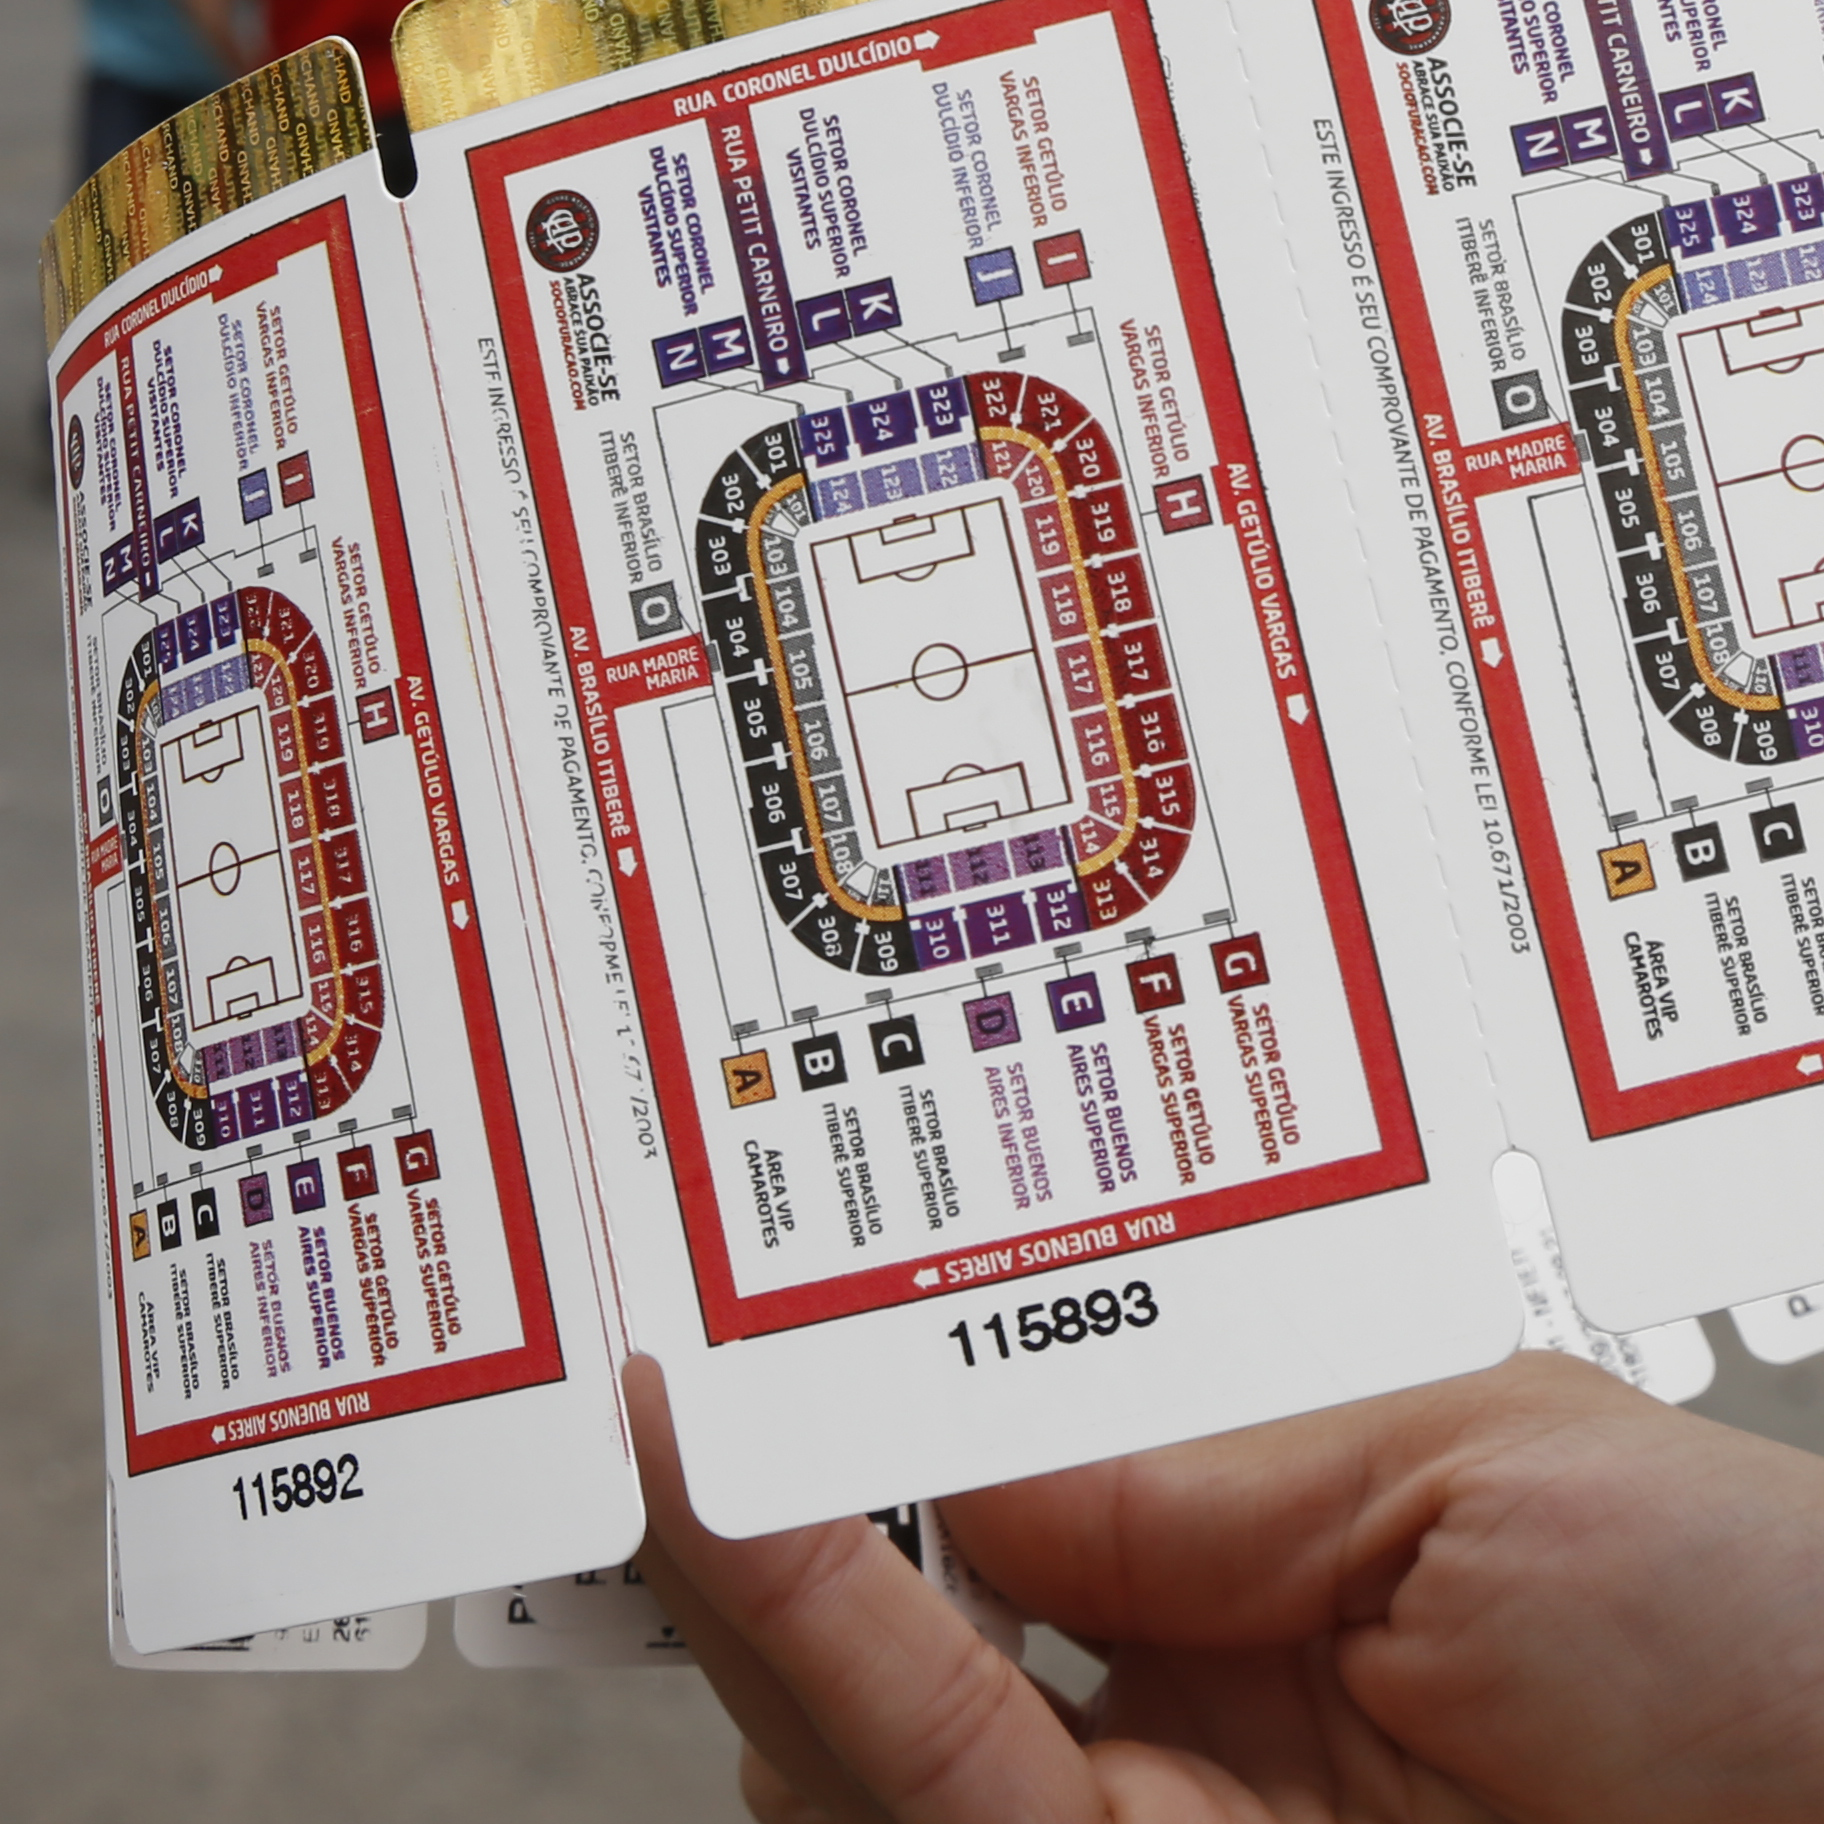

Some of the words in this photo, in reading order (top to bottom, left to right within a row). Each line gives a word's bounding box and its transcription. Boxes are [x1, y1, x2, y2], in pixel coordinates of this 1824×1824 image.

[1521, 14, 1559, 105] SUPERIOR
[1541, 0, 1575, 83] CORONEL
[672, 88, 717, 117] RUA
[721, 61, 816, 104] CORONEL
[816, 30, 913, 77] DULCÍDIO
[1604, 31, 1652, 145] CARNEIRO
[1425, 54, 1477, 190] ASSOCIE-SE
[1672, 100, 1704, 124] L
[1719, 86, 1753, 115] K
[719, 123, 749, 175] RUA
[799, 106, 834, 189] DULCÍDIO
[822, 113, 849, 173] SETOR
[1313, 115, 1342, 167] ESTE
[1524, 130, 1559, 159] N
[1571, 117, 1606, 150] M
[730, 174, 763, 240] PETIT
[785, 146, 821, 251] VISITANTES
[835, 173, 868, 257] CORONEL
[1325, 167, 1367, 271] INGRESSO
[816, 189, 850, 278] SUPERIOR
[103, 322, 119, 348] RUA
[120, 296, 160, 336] CORONEL
[159, 265, 208, 311] DULCÍDIO
[562, 274, 584, 327] ABRACE
[744, 240, 789, 354] CARNEIRO
[1350, 271, 1375, 289] É
[575, 270, 620, 404] ASSOCIE-SE
[1354, 290, 1382, 333] SEU
[572, 327, 590, 356] SUA
[121, 354, 133, 402] RUA
[578, 355, 602, 408] PAIXÃO
[1502, 382, 1538, 416] O
[125, 401, 139, 463] PETIT
[1365, 333, 1420, 491] COMPROVANTE
[1422, 410, 1448, 445] AV.
[764, 431, 789, 473] 301
[1225, 459, 1252, 496] AV.
[1463, 449, 1502, 471] RUA
[1505, 433, 1567, 461] MADRE
[1508, 452, 1567, 480] MARIA
[131, 463, 150, 568] CARNEIRO
[721, 472, 745, 514] 302
[1403, 491, 1428, 524] DE
[1430, 446, 1476, 546] BRASÍLIO
[708, 535, 732, 577] 303
[1234, 497, 1279, 591] GETÚLIO
[331, 536, 352, 606] VARGAS
[342, 607, 367, 690] INFERIOR
[346, 541, 366, 599] SETOR
[357, 600, 383, 676] GETÚLIO
[1455, 546, 1497, 629] ITIBERÊ
[568, 622, 590, 657] AV.
[725, 616, 749, 658] 304
[1257, 592, 1296, 680] VARGAS
[604, 660, 639, 683] RUA
[641, 644, 699, 673] MADRE
[644, 663, 698, 691] MARIA
[574, 657, 614, 756] BRASÍLIO
[743, 697, 766, 739] 305
[1443, 658, 1489, 777] CONFORME
[1799, 706, 1824, 748] 310
[413, 709, 446, 800] GETÚLIO
[430, 801, 459, 886] VARGAS
[595, 756, 631, 838] ITIBERÊ
[761, 782, 785, 824] 306
[1473, 778, 1497, 812] LEI
[1683, 838, 1717, 867] B
[1760, 819, 1794, 846] C
[1479, 815, 1533, 956] 10.671/2003
[1609, 854, 1643, 886] A
[1704, 891, 1733, 954] ITIBERÊ
[1719, 955, 1751, 1037] SUPERIOR
[1724, 896, 1748, 948] SETOR
[1737, 950, 1769, 1025] BRASÍLIO
[763, 1146, 790, 1198] ÁREA
[898, 1083, 927, 1147] ITIBERÊ
[913, 1148, 943, 1230] SUPERIOR
[920, 1088, 943, 1141] SETOR
[932, 1143, 963, 1218] BRASÍLIO
[742, 1138, 780, 1251] CAMAROTES
[773, 1199, 794, 1234] VIP
[298, 1223, 316, 1277] AIRES
[1014, 1224, 1116, 1267] BUENOS
[1122, 1211, 1175, 1243] RUA
[313, 1226, 332, 1284] SETOR
[941, 1247, 1012, 1283] AIRES
[306, 1279, 330, 1370] SUPERIOR
[322, 1287, 344, 1362] BUENOS
[947, 1277, 1164, 1369] 115893
[228, 1412, 267, 1441] AIRES
[268, 1399, 331, 1432] BUENOS
[334, 1391, 370, 1418] RUA
[231, 1452, 363, 1521] 115892
